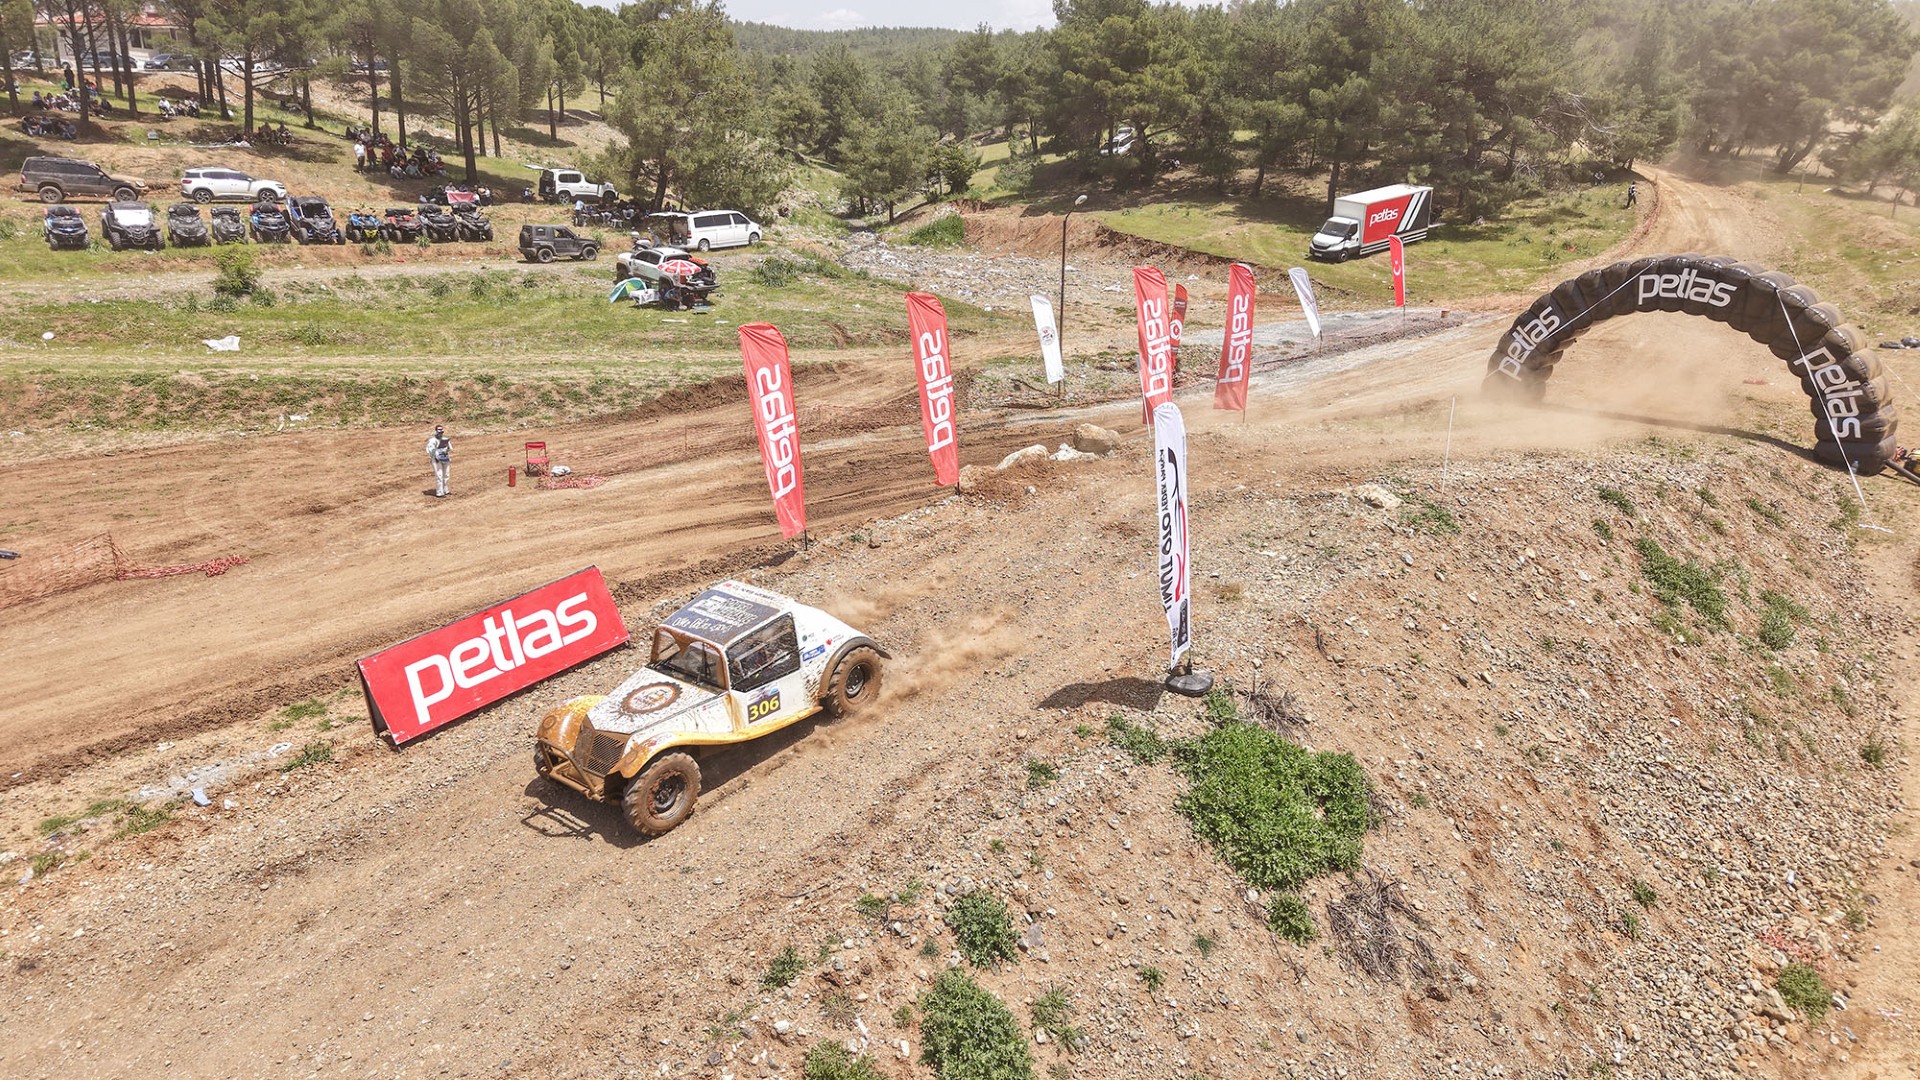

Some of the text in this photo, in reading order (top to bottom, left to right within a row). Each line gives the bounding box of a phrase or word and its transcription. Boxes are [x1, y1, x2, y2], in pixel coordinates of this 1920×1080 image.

[1369, 207, 1399, 227] petlas
[1637, 268, 1738, 307] petlas
[1498, 306, 1561, 382] petlas
[1794, 346, 1864, 439] petlas
[404, 591, 598, 725] petlas
[749, 695, 780, 721] 306
